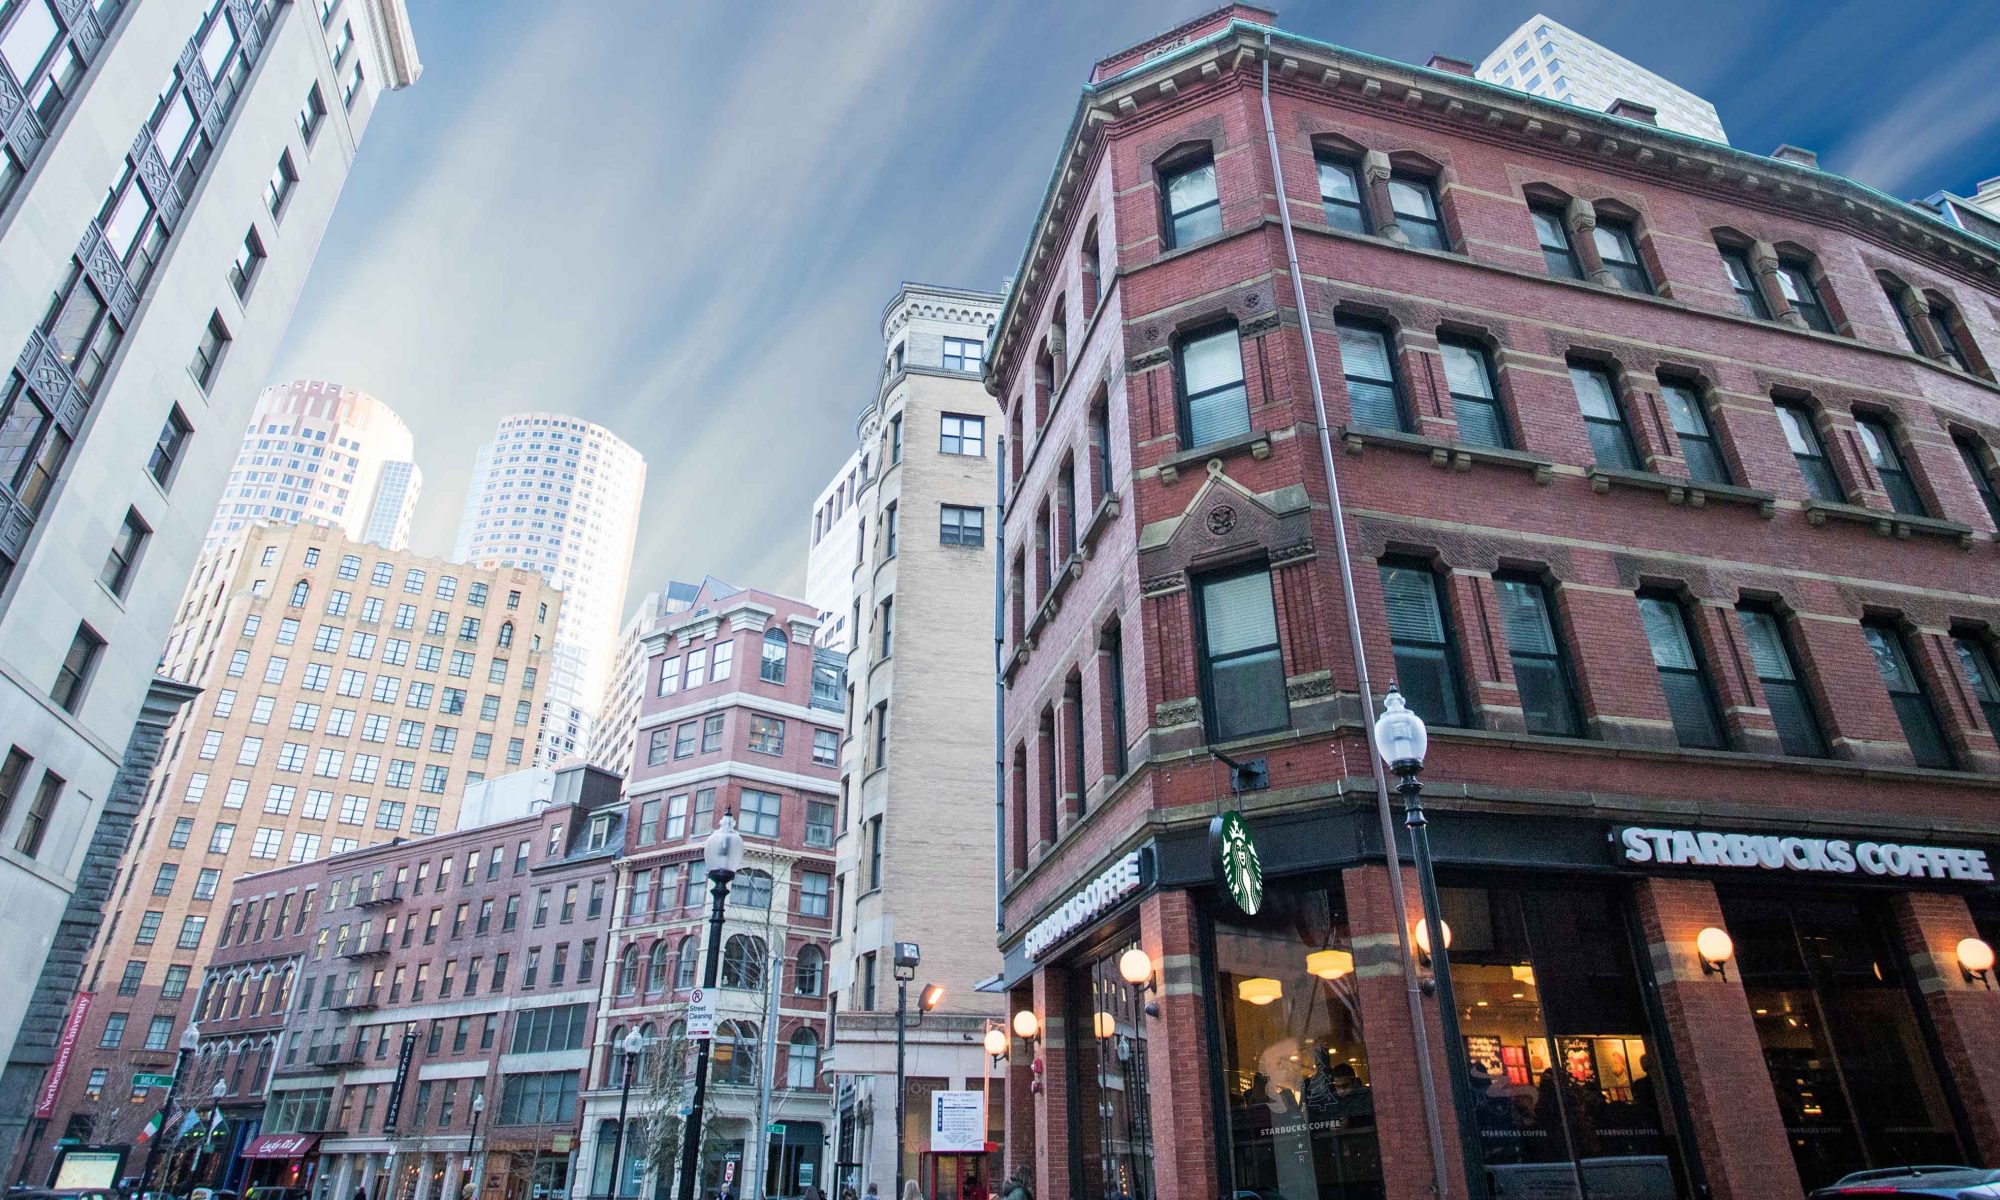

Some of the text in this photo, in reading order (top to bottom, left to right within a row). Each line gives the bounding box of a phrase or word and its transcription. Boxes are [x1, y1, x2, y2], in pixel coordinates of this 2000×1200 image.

[1622, 826, 1995, 881] STARBUCKS COFFEE
[1024, 851, 1140, 960] STARBUCKS COFFEE
[40, 997, 90, 1111] Northeastern University
[1260, 1120, 1341, 1136] STARBUCKS COFFEE
